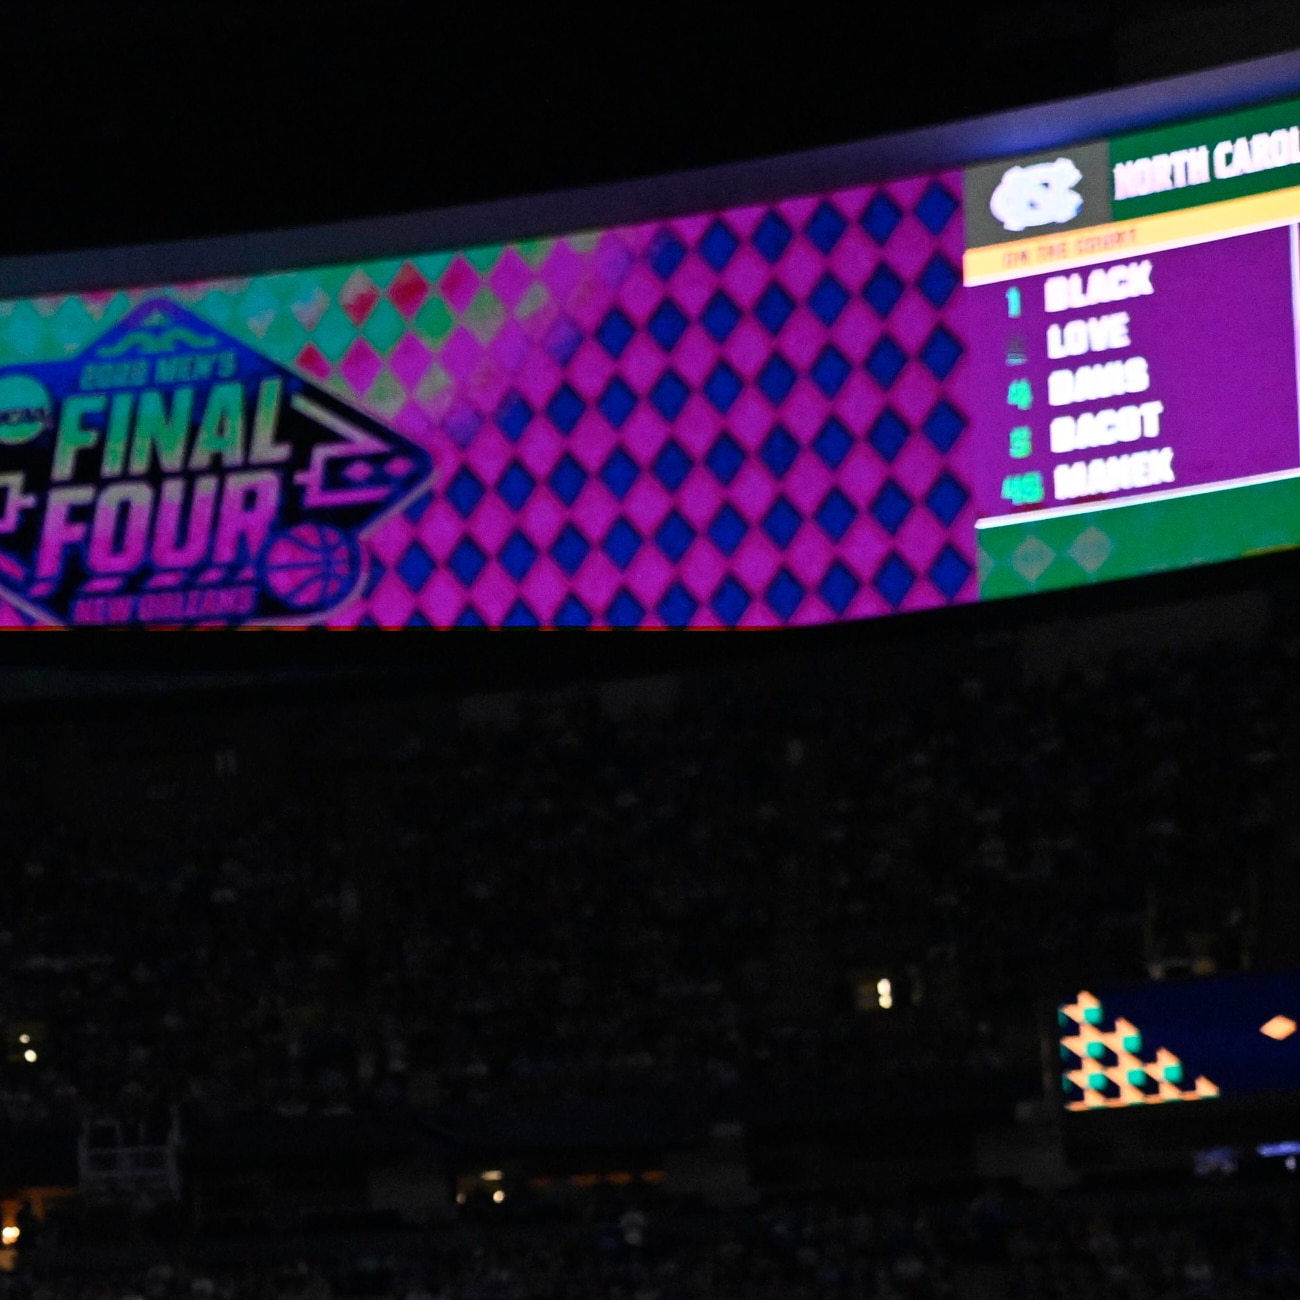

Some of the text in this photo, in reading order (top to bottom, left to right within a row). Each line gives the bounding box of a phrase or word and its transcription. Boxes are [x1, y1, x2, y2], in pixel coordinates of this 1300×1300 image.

[1112, 145, 1211, 200] NORTH
[1045, 260, 1153, 312] BLACK
[1047, 312, 1131, 359] LOVE
[52, 376, 292, 481] FINAL
[32, 472, 280, 580] FOUR
